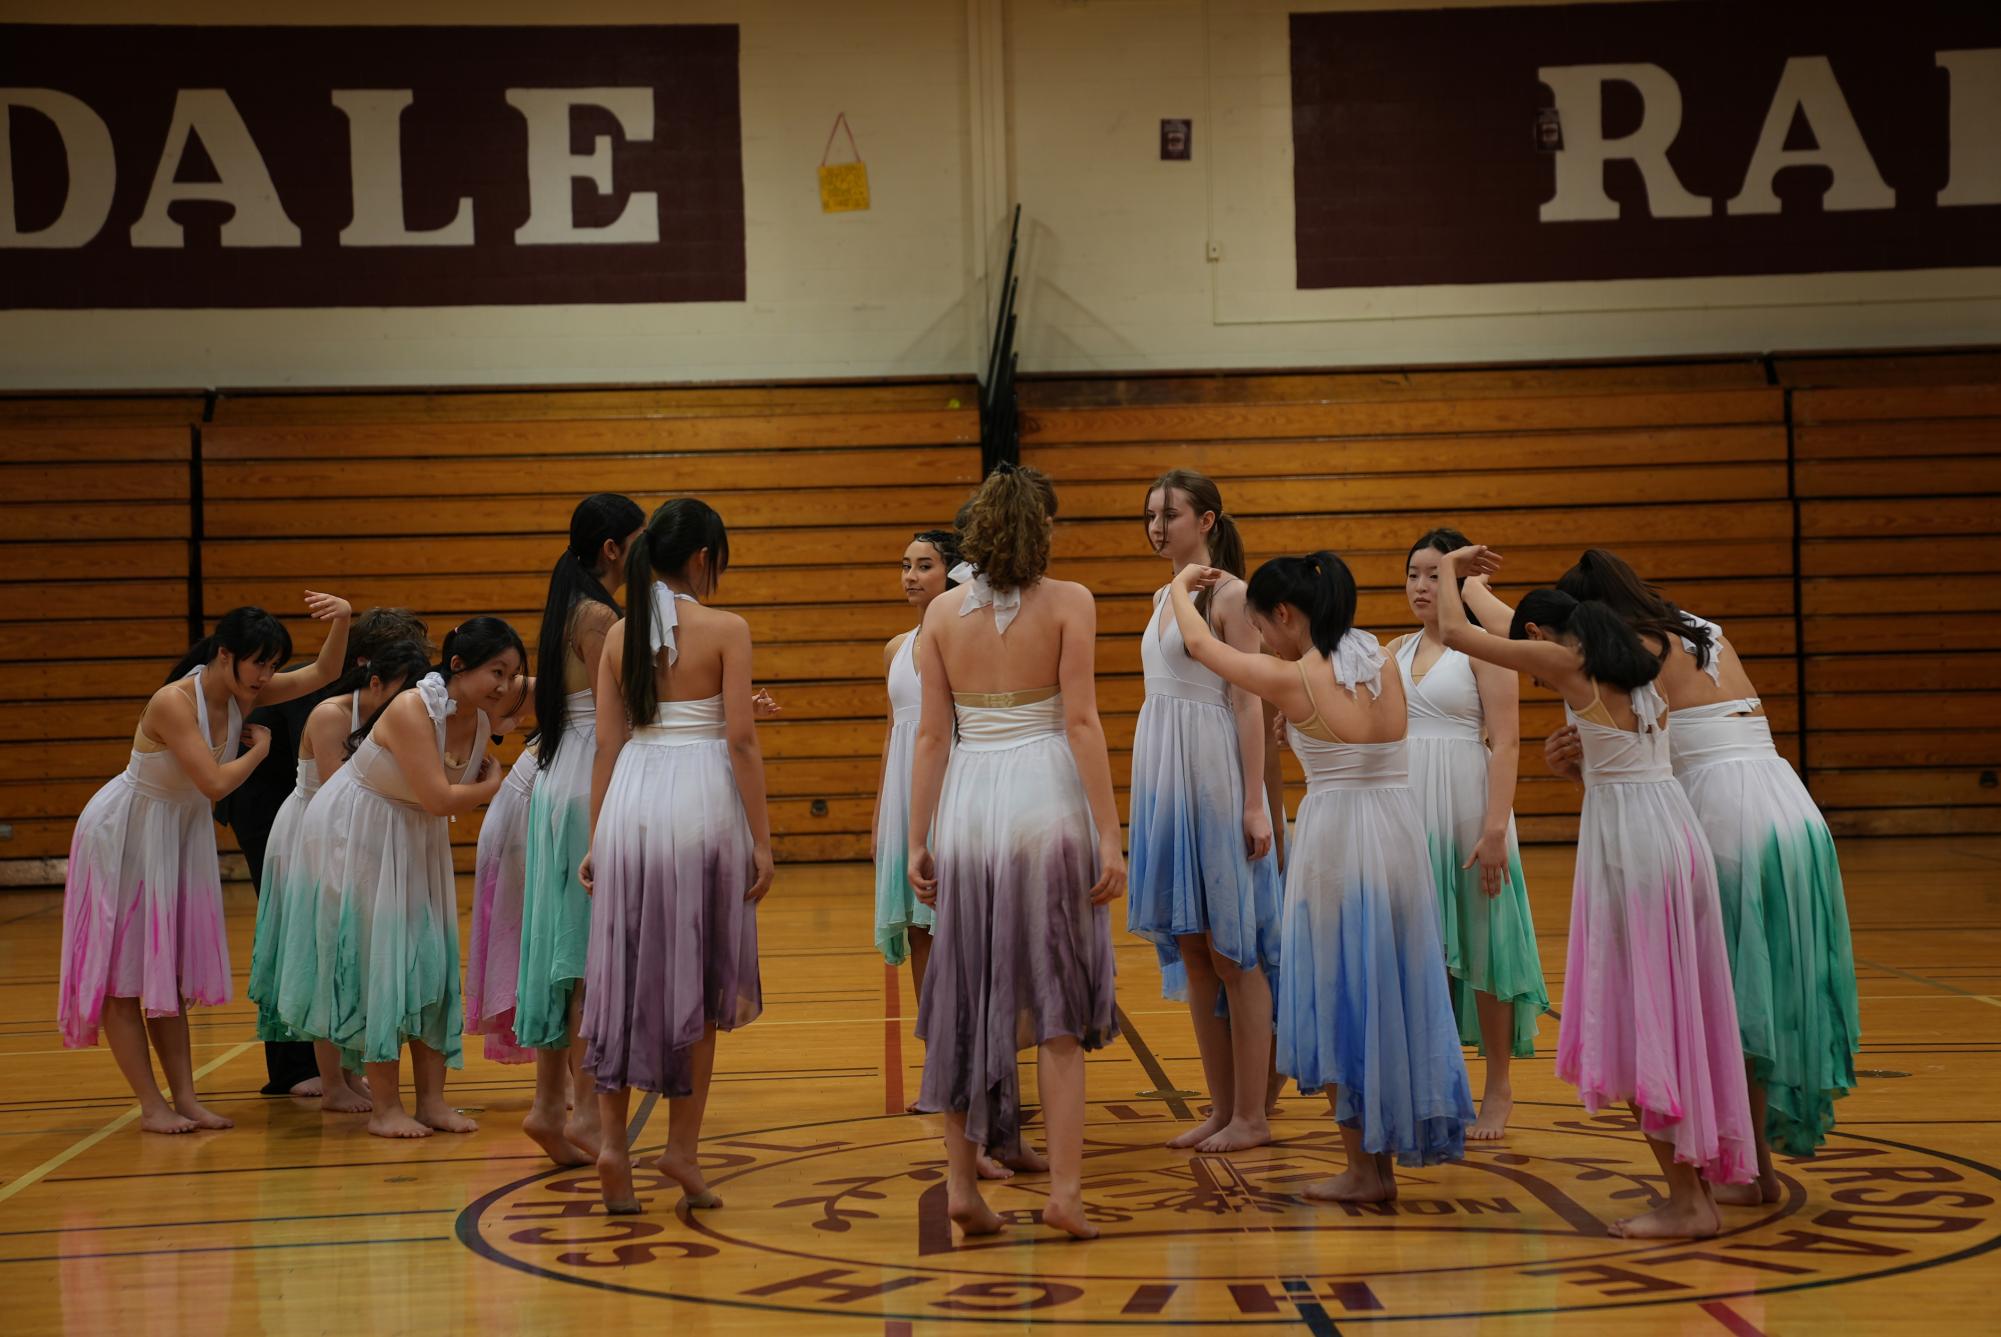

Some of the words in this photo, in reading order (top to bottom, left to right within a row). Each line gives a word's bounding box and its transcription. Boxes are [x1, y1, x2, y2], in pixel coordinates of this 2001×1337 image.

[0, 87, 659, 247] DALE
[502, 1140, 855, 1267] SCHOOL
[738, 1268, 1386, 1314] HIGH
